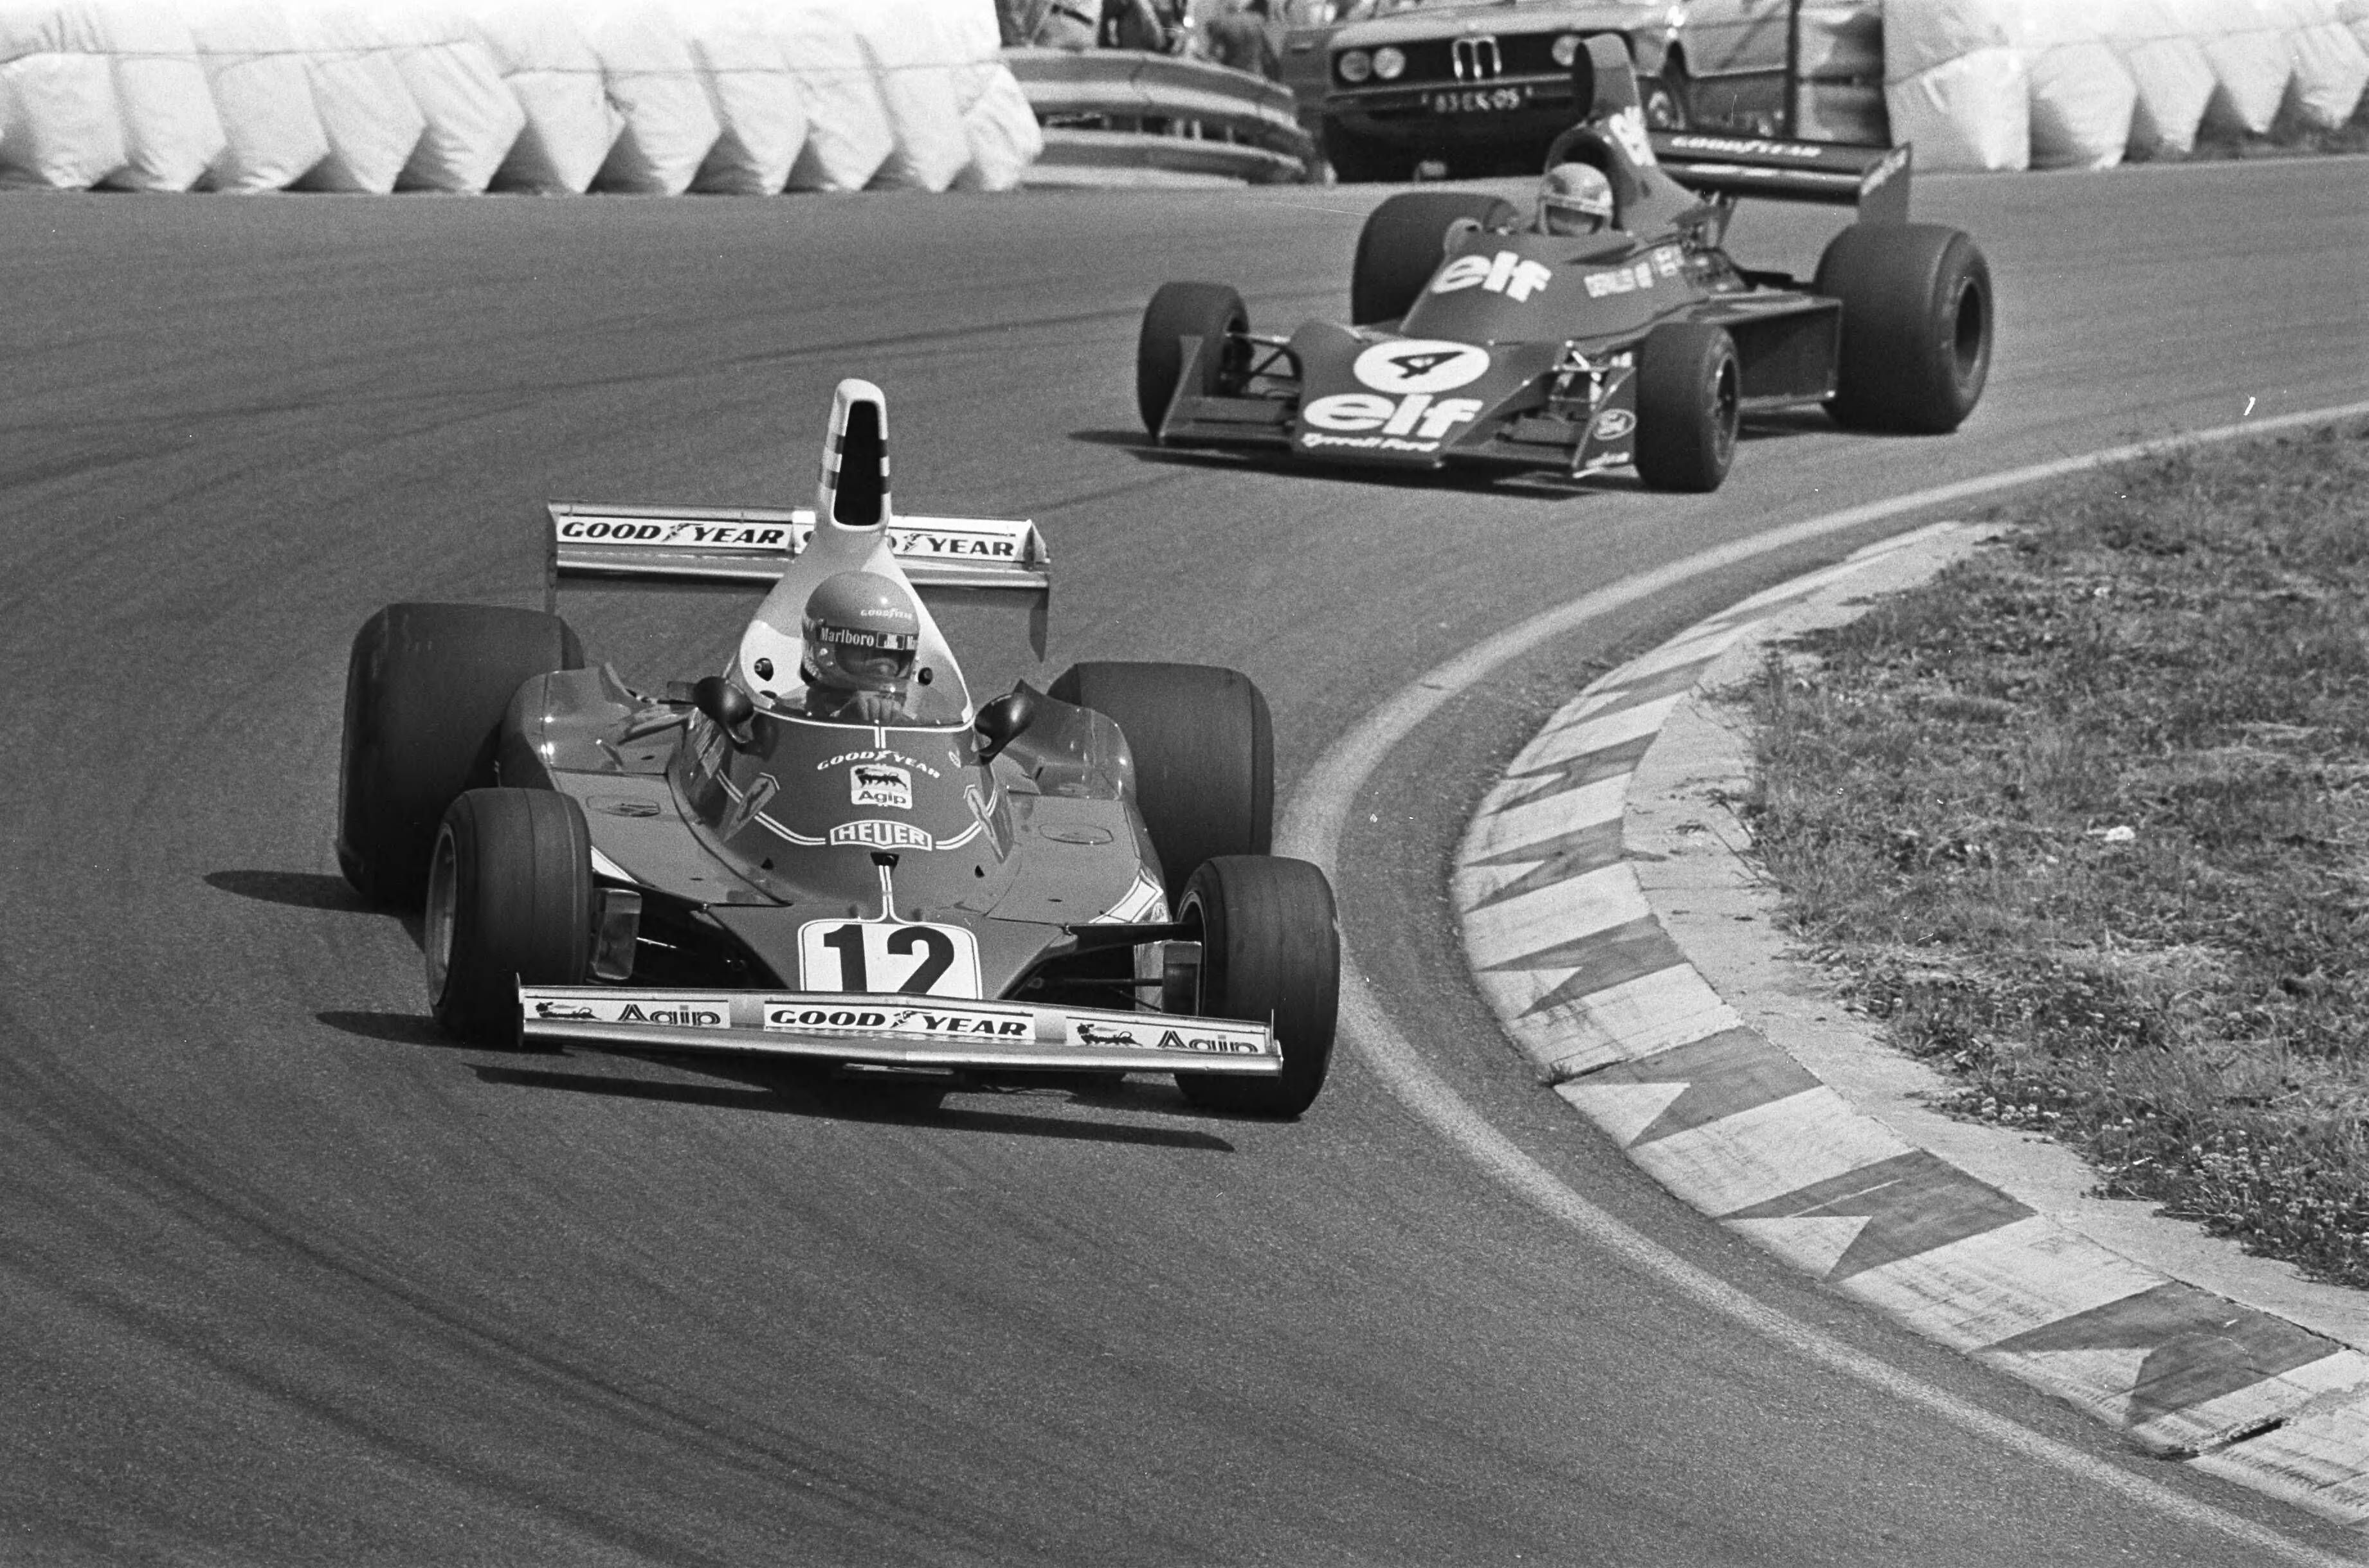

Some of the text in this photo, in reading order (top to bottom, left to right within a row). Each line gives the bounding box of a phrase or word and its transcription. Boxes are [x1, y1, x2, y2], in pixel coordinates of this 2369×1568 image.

[1431, 250, 1552, 302] elf
[1387, 350, 1467, 380] 4
[1303, 393, 1483, 438] elf
[561, 521, 662, 540] GOOD
[693, 525, 785, 545] YEAR
[927, 537, 1014, 557] YEAR
[820, 627, 875, 647] Marlboro
[817, 750, 875, 770] GOOD
[858, 790, 907, 804] Agip
[838, 822, 926, 845] HEUER
[823, 923, 955, 995] 12
[770, 1009, 1028, 1036] GOOD YEAR
